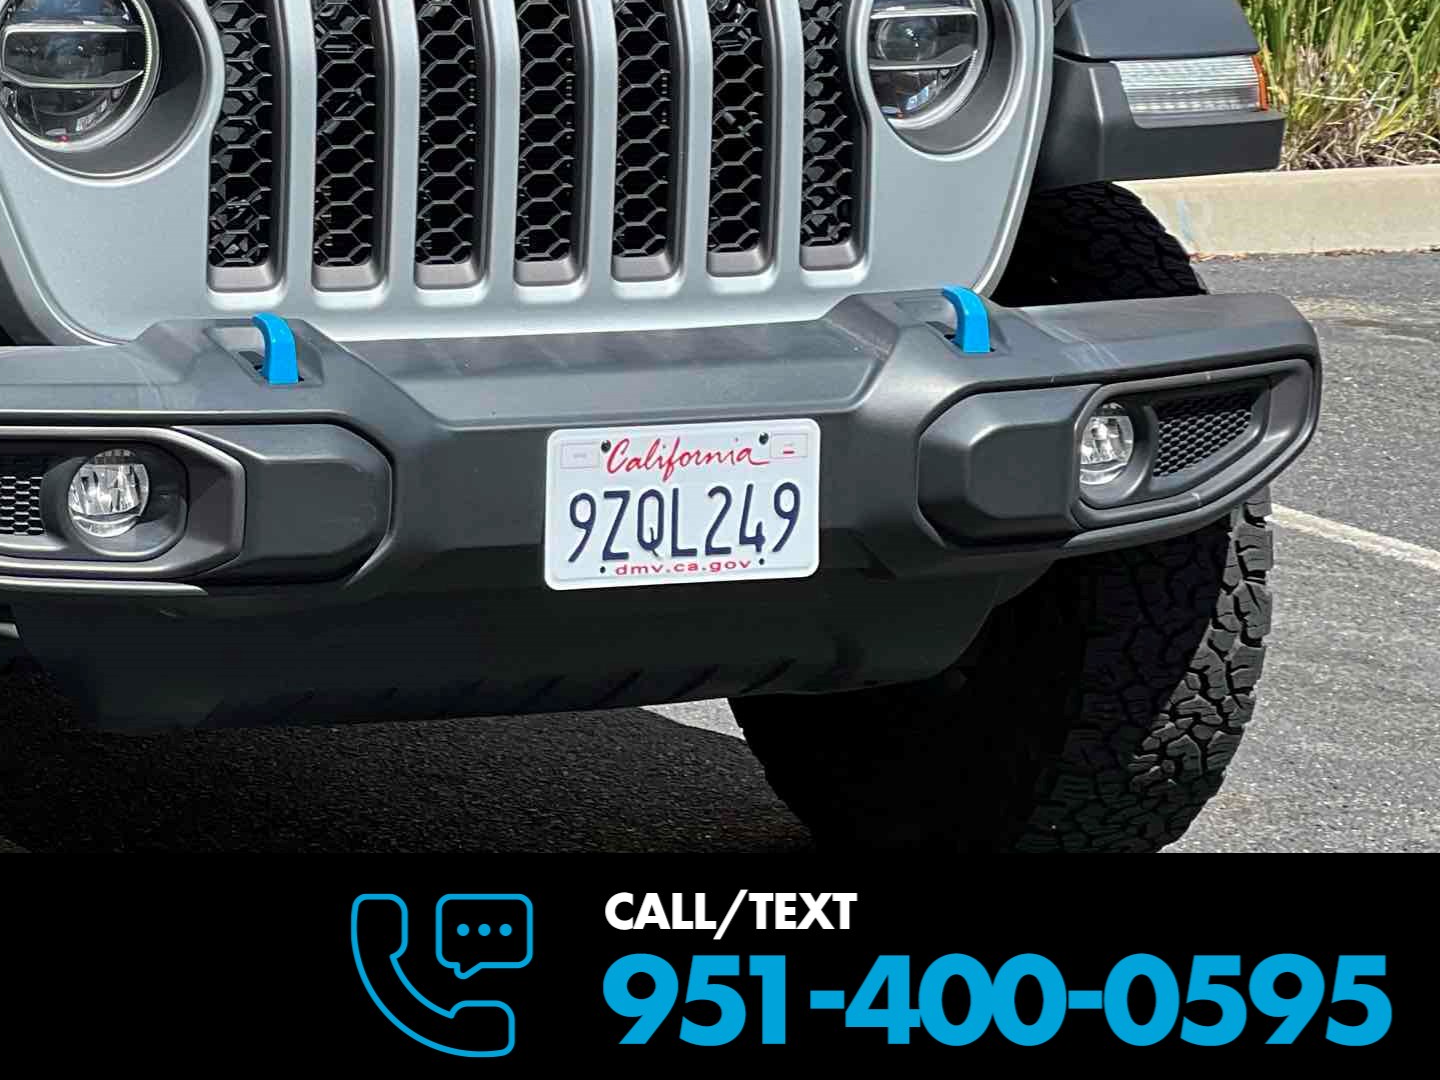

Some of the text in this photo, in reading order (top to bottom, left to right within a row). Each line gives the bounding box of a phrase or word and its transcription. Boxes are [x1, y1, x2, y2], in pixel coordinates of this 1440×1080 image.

[606, 437, 770, 482] California
[568, 482, 801, 563] 9ZQL249
[615, 559, 751, 576] dmv.ca.gov
